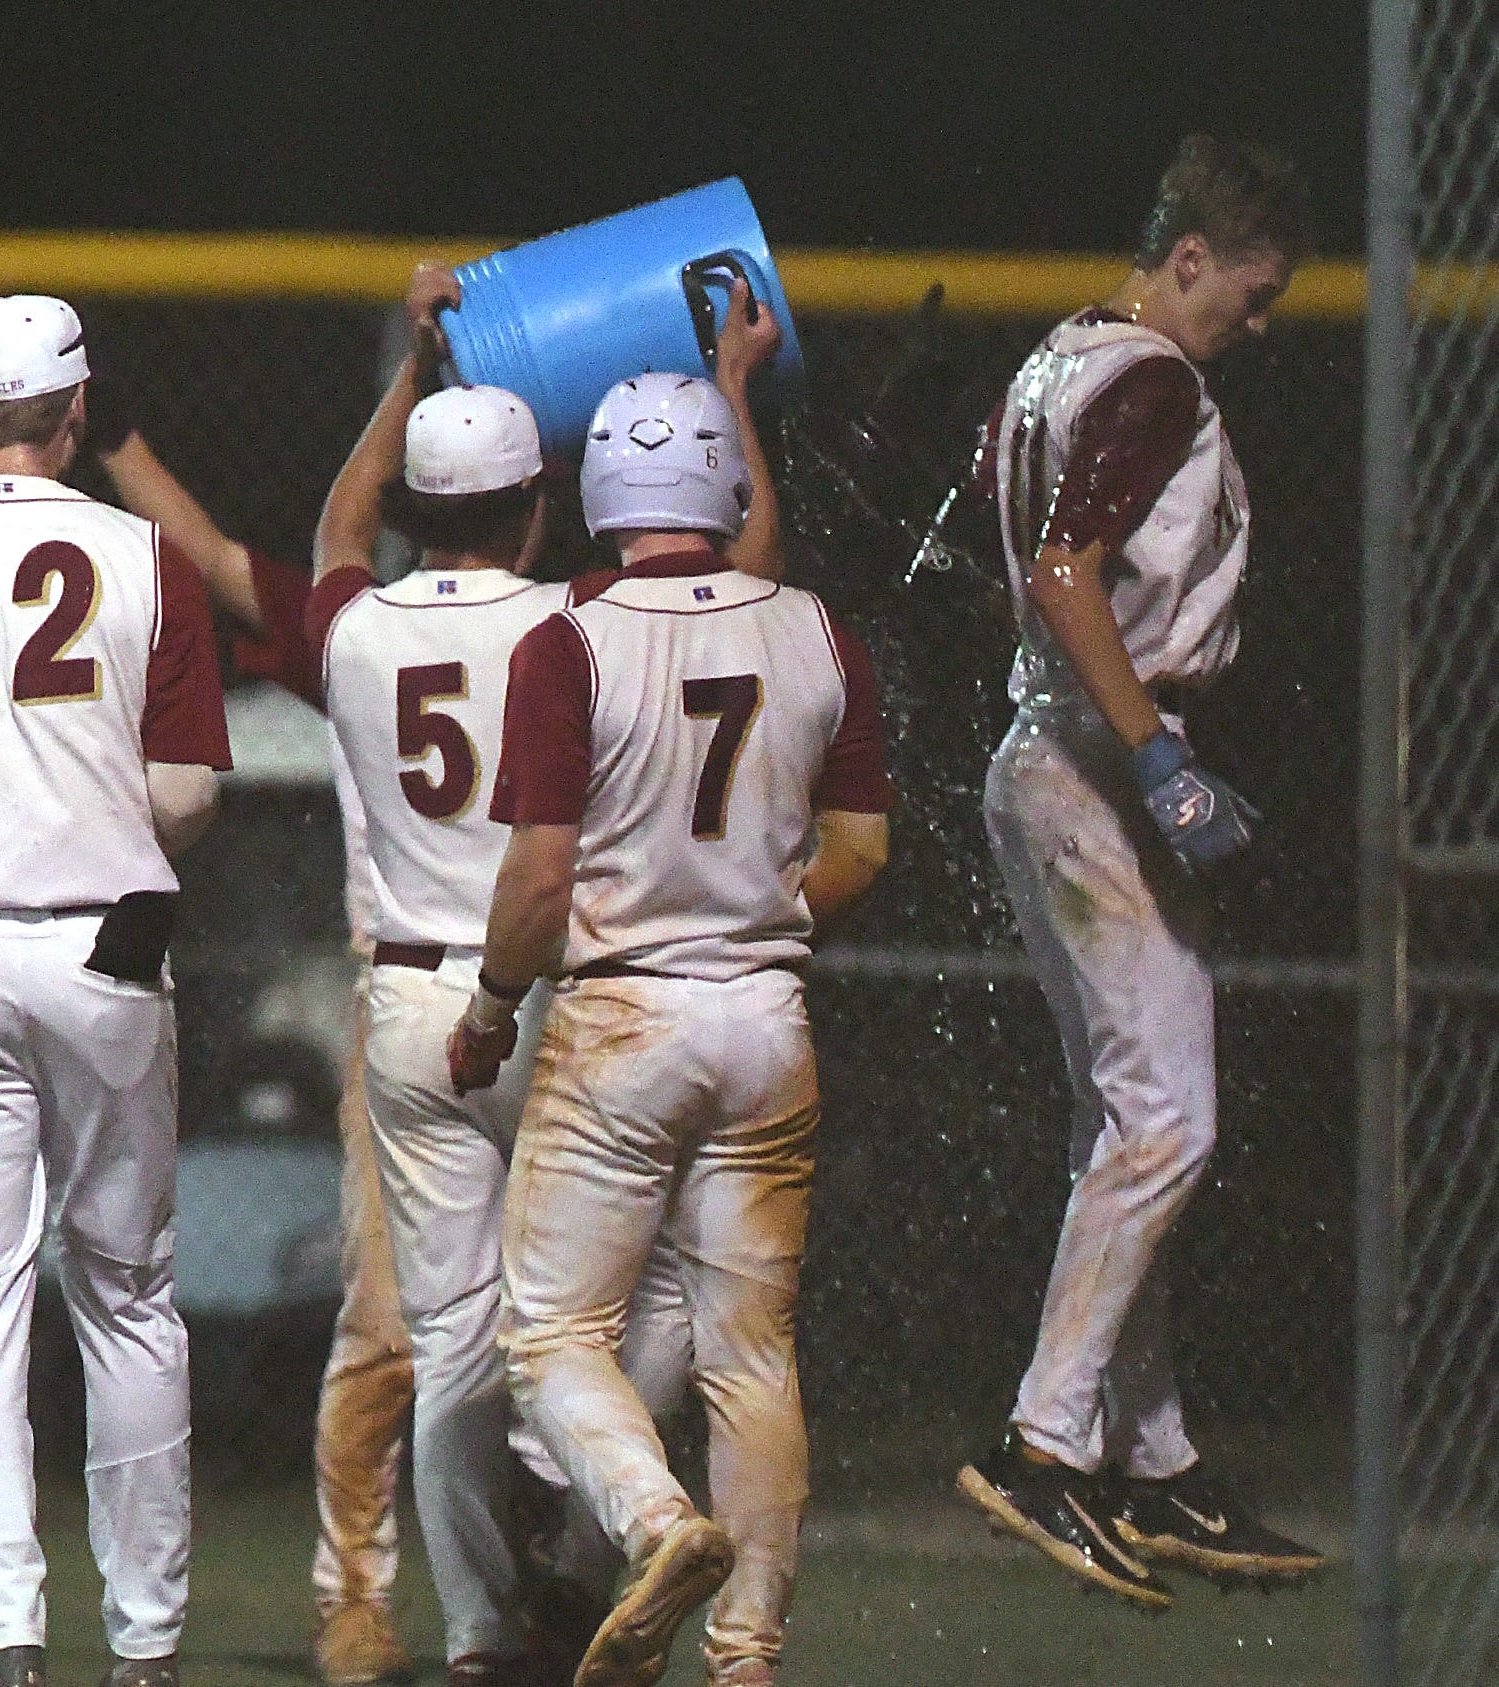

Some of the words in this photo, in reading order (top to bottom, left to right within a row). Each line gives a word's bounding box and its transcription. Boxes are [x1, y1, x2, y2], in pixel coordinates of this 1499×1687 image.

[706, 445, 718, 469] 6
[397, 661, 482, 822] 5
[683, 673, 765, 842] 7
